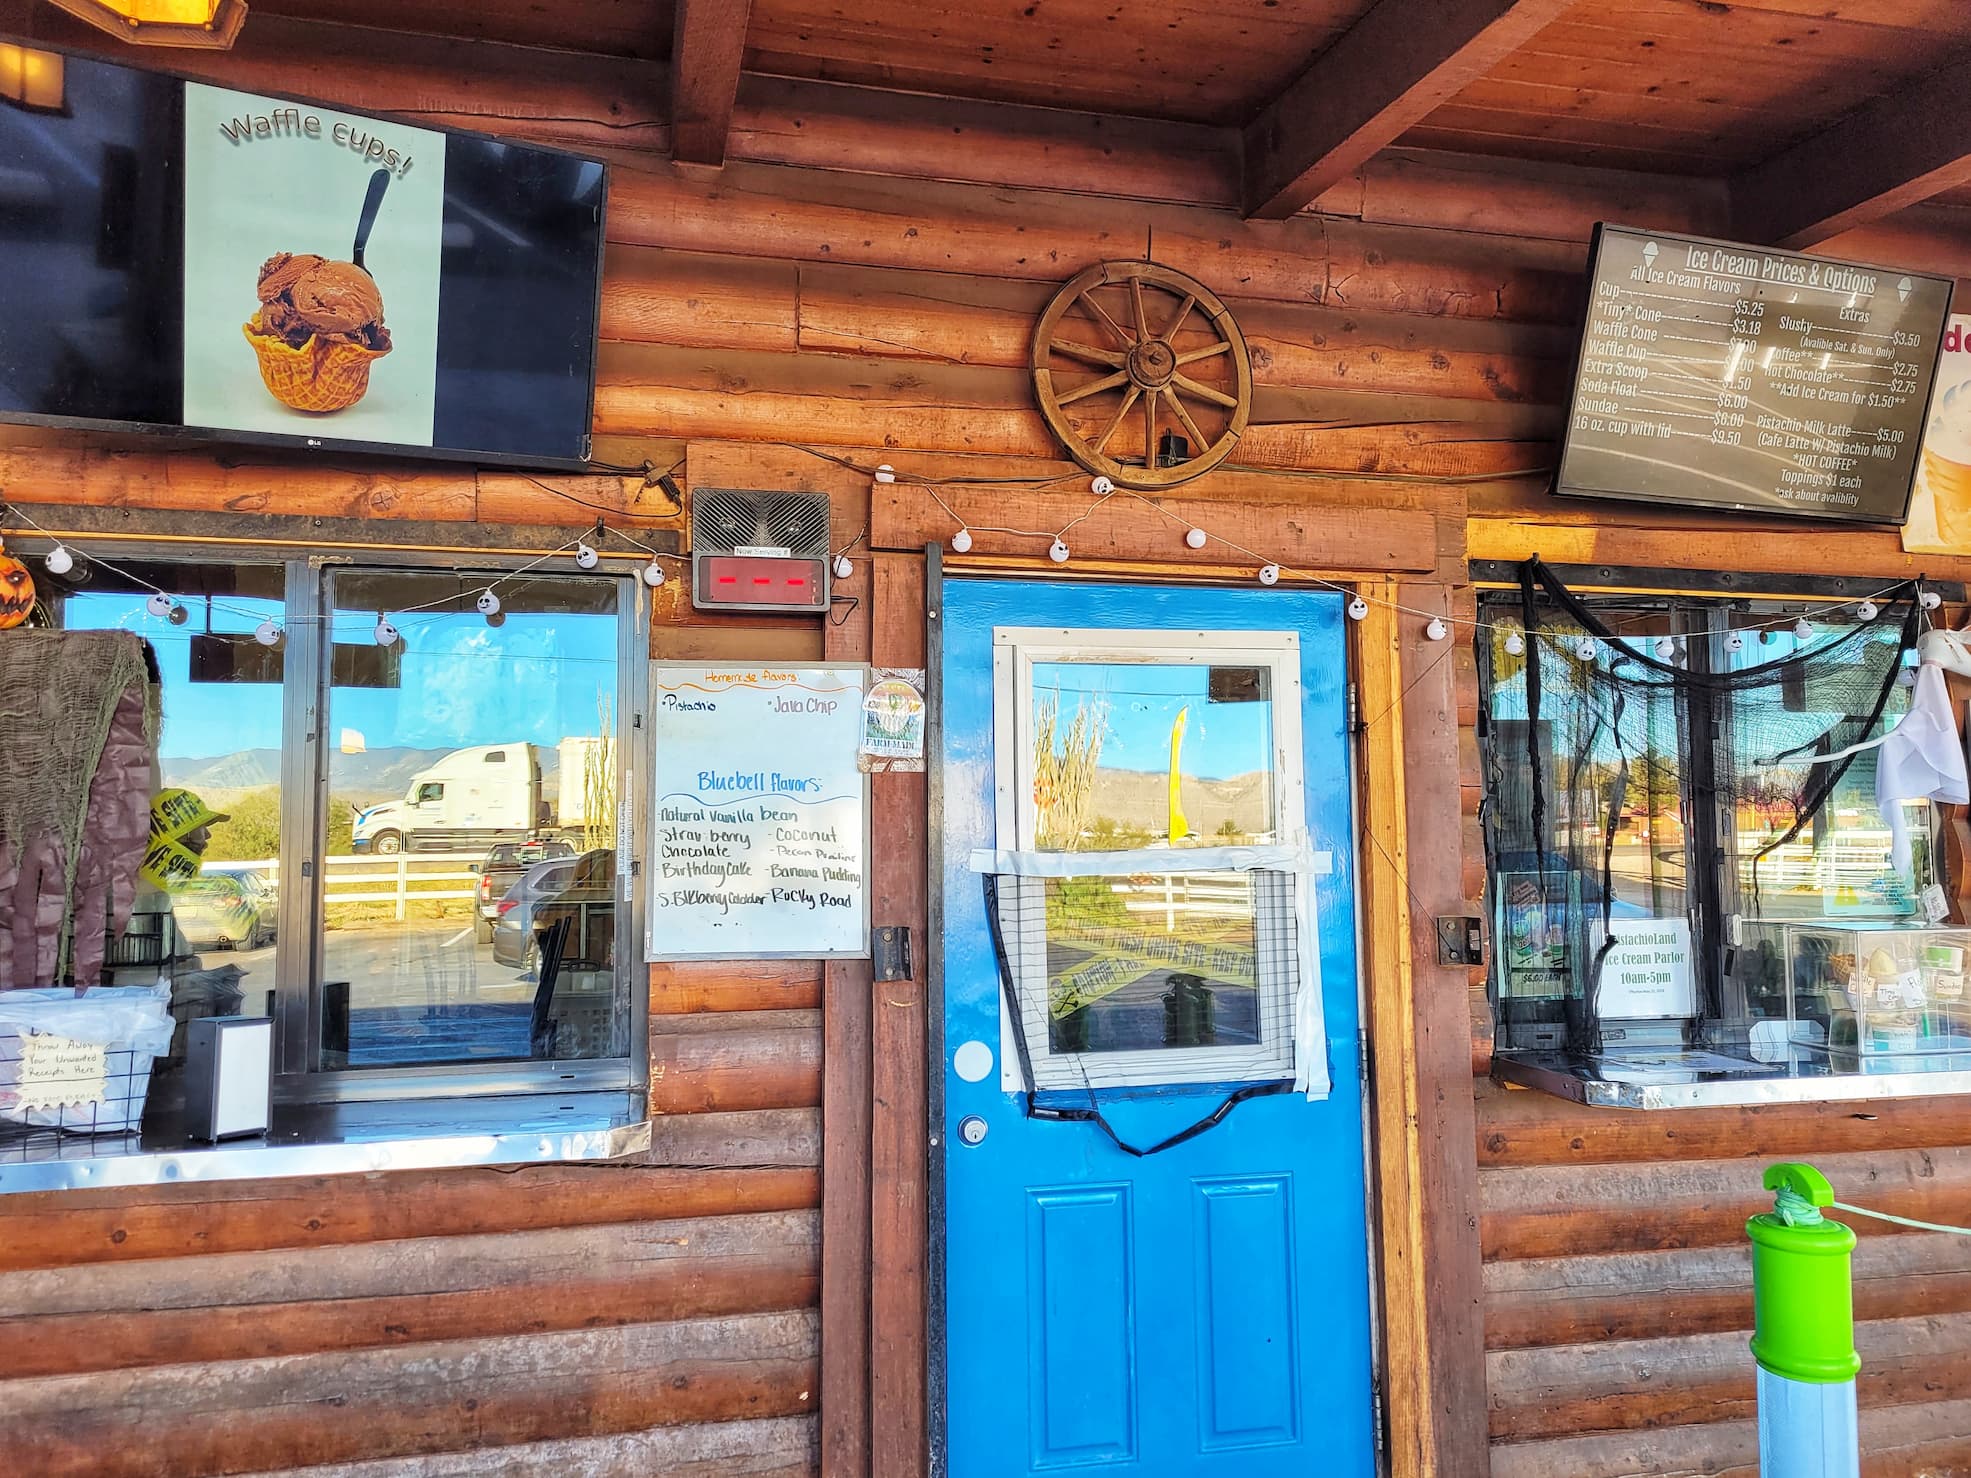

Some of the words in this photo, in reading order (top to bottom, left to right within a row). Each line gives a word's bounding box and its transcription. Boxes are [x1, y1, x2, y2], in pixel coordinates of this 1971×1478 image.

[220, 108, 321, 142] Waffle
[332, 122, 412, 174] cups!
[1630, 265, 1645, 281] All
[1648, 267, 1664, 283] Ice
[1666, 271, 1700, 288] Cream
[1703, 275, 1741, 295] Flavors
[1686, 245, 1708, 269] Ice
[1712, 250, 1758, 276] Cream
[1762, 256, 1806, 283] Prices
[1808, 263, 1820, 286] &
[1823, 266, 1877, 294] Options
[1600, 281, 1621, 300] Cup
[1734, 298, 1764, 317] $5.25
[1635, 305, 1662, 323] Cone
[1732, 317, 1762, 335] $3.18
[1840, 306, 1870, 323] Extras
[1594, 319, 1628, 338] Waffle
[1631, 324, 1658, 342] Cone
[1728, 336, 1757, 354] $00
[1779, 316, 1814, 336] Slushy
[1892, 330, 1921, 347] $3.50
[1589, 339, 1624, 357] Waffle
[1626, 343, 1648, 361] Cup
[1723, 355, 1755, 372] $.00
[1800, 335, 1833, 351] (Avalible
[1834, 340, 1849, 353] Sat.
[1850, 343, 1857, 353] &
[1858, 343, 1874, 356] Sun.
[1876, 347, 1897, 360] Only)
[1585, 358, 1613, 375] Extra
[1615, 361, 1648, 381] Scoop
[1772, 347, 1814, 362] offee
[1892, 361, 1918, 378] $2.75
[1764, 365, 1781, 378] Hot
[1890, 378, 1917, 394] $2.75
[1581, 377, 1609, 394] Soda
[1610, 380, 1638, 397] Float
[1717, 392, 1748, 409] $6.00
[1802, 386, 1816, 400] Ice
[1818, 387, 1849, 403] Cream
[1851, 391, 1867, 404] for
[1577, 397, 1618, 414] Sundae
[1713, 410, 1744, 428] $6.00
[1575, 415, 1588, 430] 16
[1590, 418, 1605, 432] oz.
[1608, 420, 1628, 436] cup
[1630, 421, 1656, 437] with
[1656, 423, 1672, 439] lid
[1711, 429, 1741, 446] $9.50
[1756, 415, 1801, 433] Pistachio
[1804, 419, 1825, 435] Milk
[1827, 422, 1851, 438] Latte
[1876, 427, 1904, 443] $5.00
[1758, 431, 1783, 447] (Cafe
[1784, 434, 1809, 450] Latte
[1826, 439, 1870, 457] Pistachio
[1871, 444, 1897, 460] Milk)
[1781, 468, 1823, 487] Toppings
[1826, 473, 1837, 487] $1
[1839, 474, 1862, 489] each
[1795, 488, 1820, 502] about
[1821, 491, 1860, 507] avaliblity
[736, 547, 752, 555] Now
[705, 671, 758, 682] Homemde
[664, 694, 716, 712] Pistachio
[774, 696, 803, 713] Java
[806, 697, 838, 715] Chip
[697, 771, 765, 791] Bluebell
[760, 806, 798, 822] bean
[662, 845, 730, 858] Chocolate
[777, 847, 812, 856] Pecan
[770, 864, 818, 879] Banana
[822, 867, 861, 889] Pudding
[820, 892, 852, 908] Road
[1616, 932, 1677, 946] istachioLand
[1605, 955, 1619, 966] Ice
[1622, 952, 1652, 966] Cream
[1654, 951, 1684, 964] Parlor
[1621, 971, 1671, 985] 10am-5pm
[68, 1040, 94, 1049] Away
[75, 1066, 95, 1074] Here
